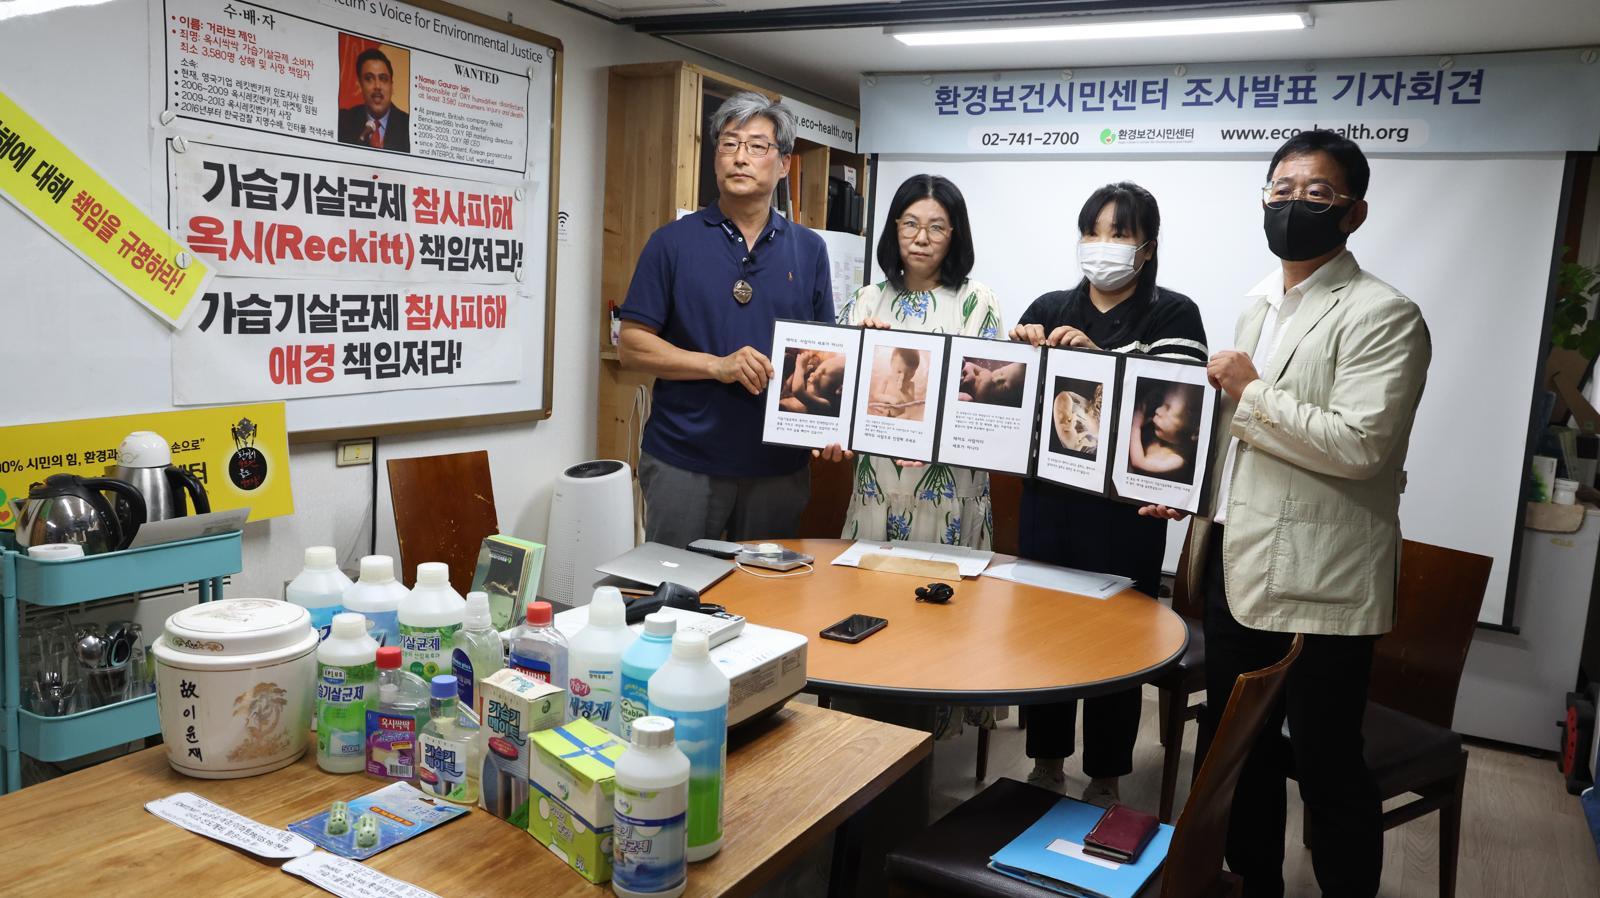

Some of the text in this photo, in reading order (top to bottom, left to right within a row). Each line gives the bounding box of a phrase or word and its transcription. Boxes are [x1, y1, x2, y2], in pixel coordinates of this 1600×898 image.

[206, 22, 237, 39] 거라브
[238, 31, 257, 44] 제인
[379, 1, 412, 24] Voice
[415, 11, 431, 28] for
[433, 20, 509, 53] Environmental
[511, 43, 543, 63] Justice
[181, 41, 198, 55] 최소
[239, 55, 256, 67] 상해
[269, 62, 286, 75] 사망
[288, 65, 310, 80] 책임자
[202, 34, 239, 51] 옥시싹싹
[242, 43, 289, 64] 가습기살균제
[291, 55, 315, 70] 소비자
[454, 63, 500, 85] WANTED
[201, 72, 233, 87] 영국기업
[235, 79, 272, 94] 레킷벤키저
[273, 87, 300, 101] 인도지사
[301, 94, 315, 105] 임원
[934, 68, 1484, 116] 환경보건시민센터 조사발표 기자회견
[181, 102, 222, 118] 2016년부터
[224, 109, 254, 124] 한국검찰
[227, 98, 277, 117] 옥시레킷벤키저
[278, 109, 292, 120] 사장
[304, 104, 318, 116] 임원
[982, 130, 1080, 146] 02-741-2700
[1117, 127, 1195, 141] 환경보건시민센터
[0, 119, 187, 296] 해에 대해 책임을 규명하라!
[202, 160, 514, 230] 가습기살균제 참사피해
[186, 215, 524, 274] 옥시(Reckitt) 책임져라!
[197, 291, 507, 335] 가습기살균제 참사피해
[268, 339, 462, 386] 애경 책임져라!
[0, 448, 118, 474] 0% 시민의 힘, 환경과
[488, 699, 521, 724] 가습기
[570, 696, 613, 722] 세정제
[487, 714, 523, 744] 메이트
[425, 743, 456, 764] 가습기
[424, 756, 460, 778] 메이트
